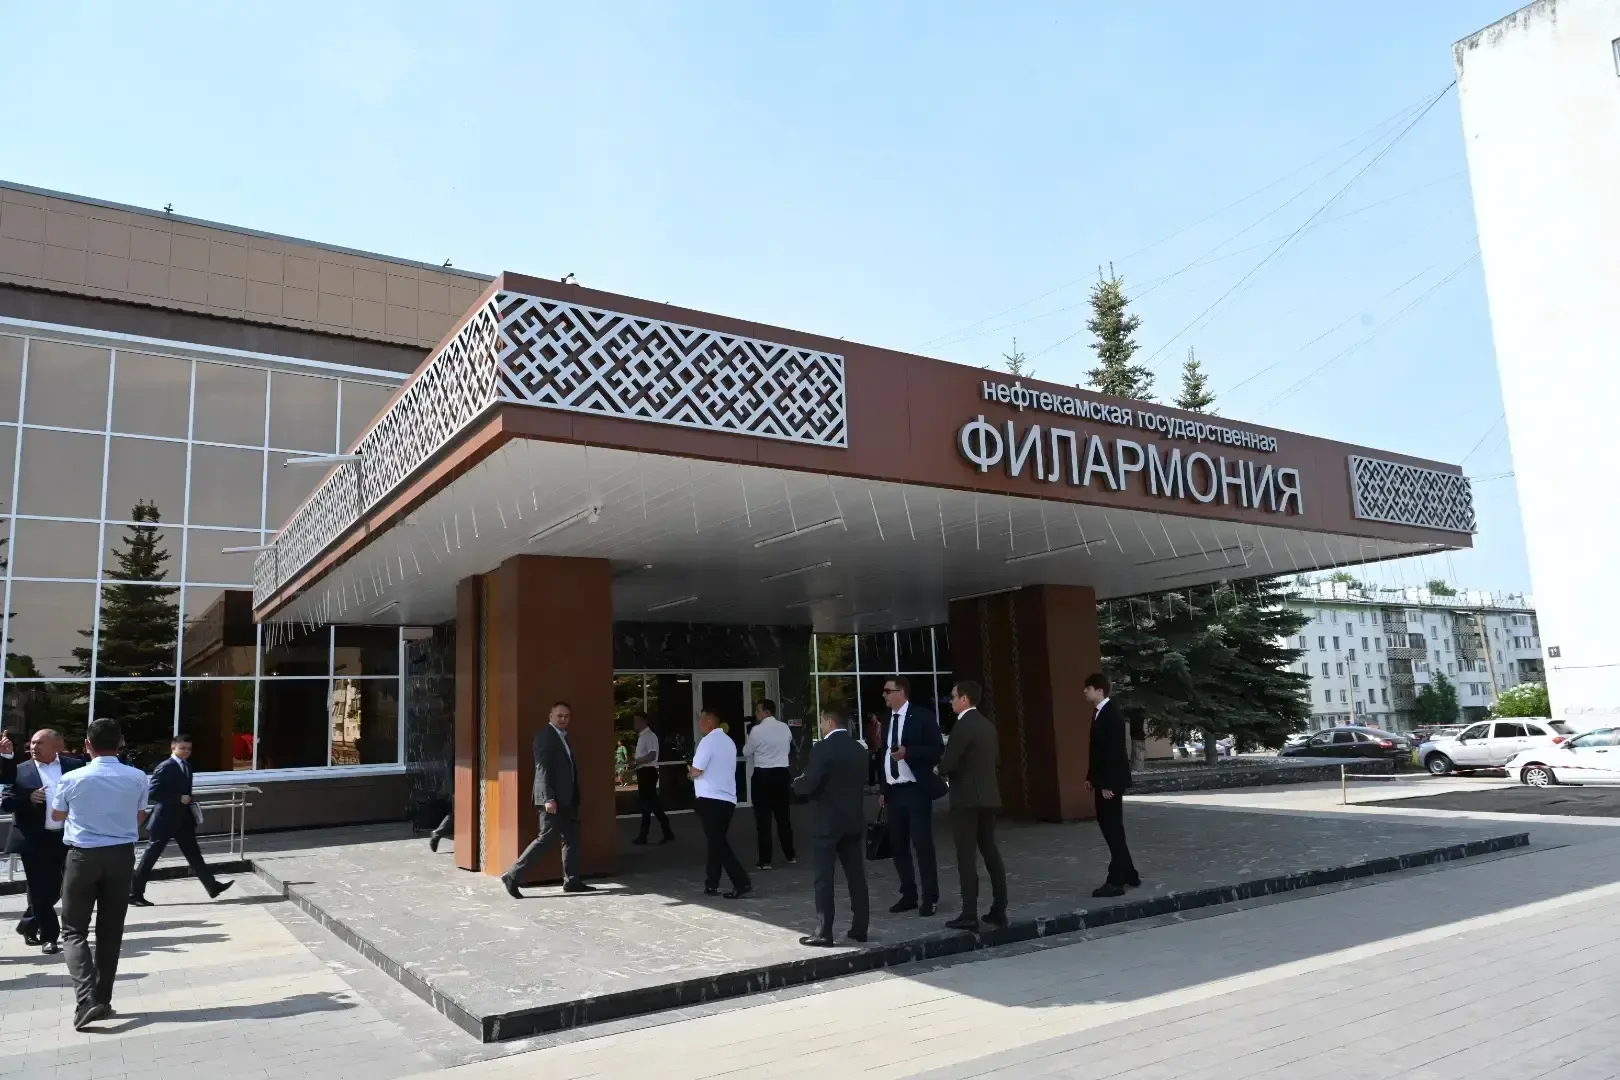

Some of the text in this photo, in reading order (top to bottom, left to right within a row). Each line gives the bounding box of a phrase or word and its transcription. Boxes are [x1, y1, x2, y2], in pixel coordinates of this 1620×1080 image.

[982, 380, 1278, 452] нефтекамская государственная
[959, 414, 1304, 515] ФИЛАРМОНИЯ
